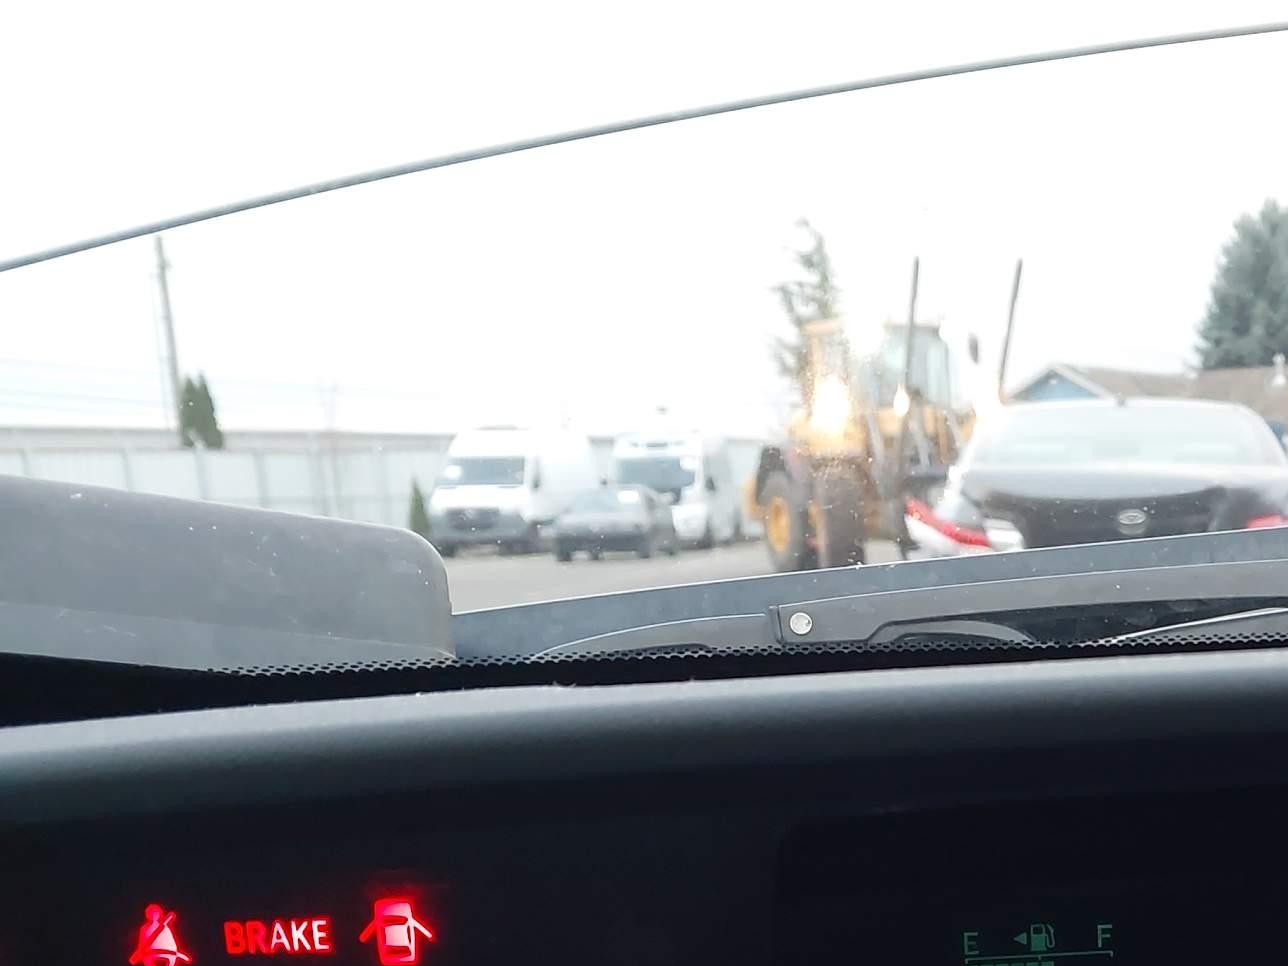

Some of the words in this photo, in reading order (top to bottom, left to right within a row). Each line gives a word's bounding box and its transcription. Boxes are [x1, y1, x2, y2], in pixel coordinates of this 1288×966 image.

[224, 919, 332, 954] BRAKE
[964, 931, 980, 955] E
[1097, 924, 1113, 947] F
